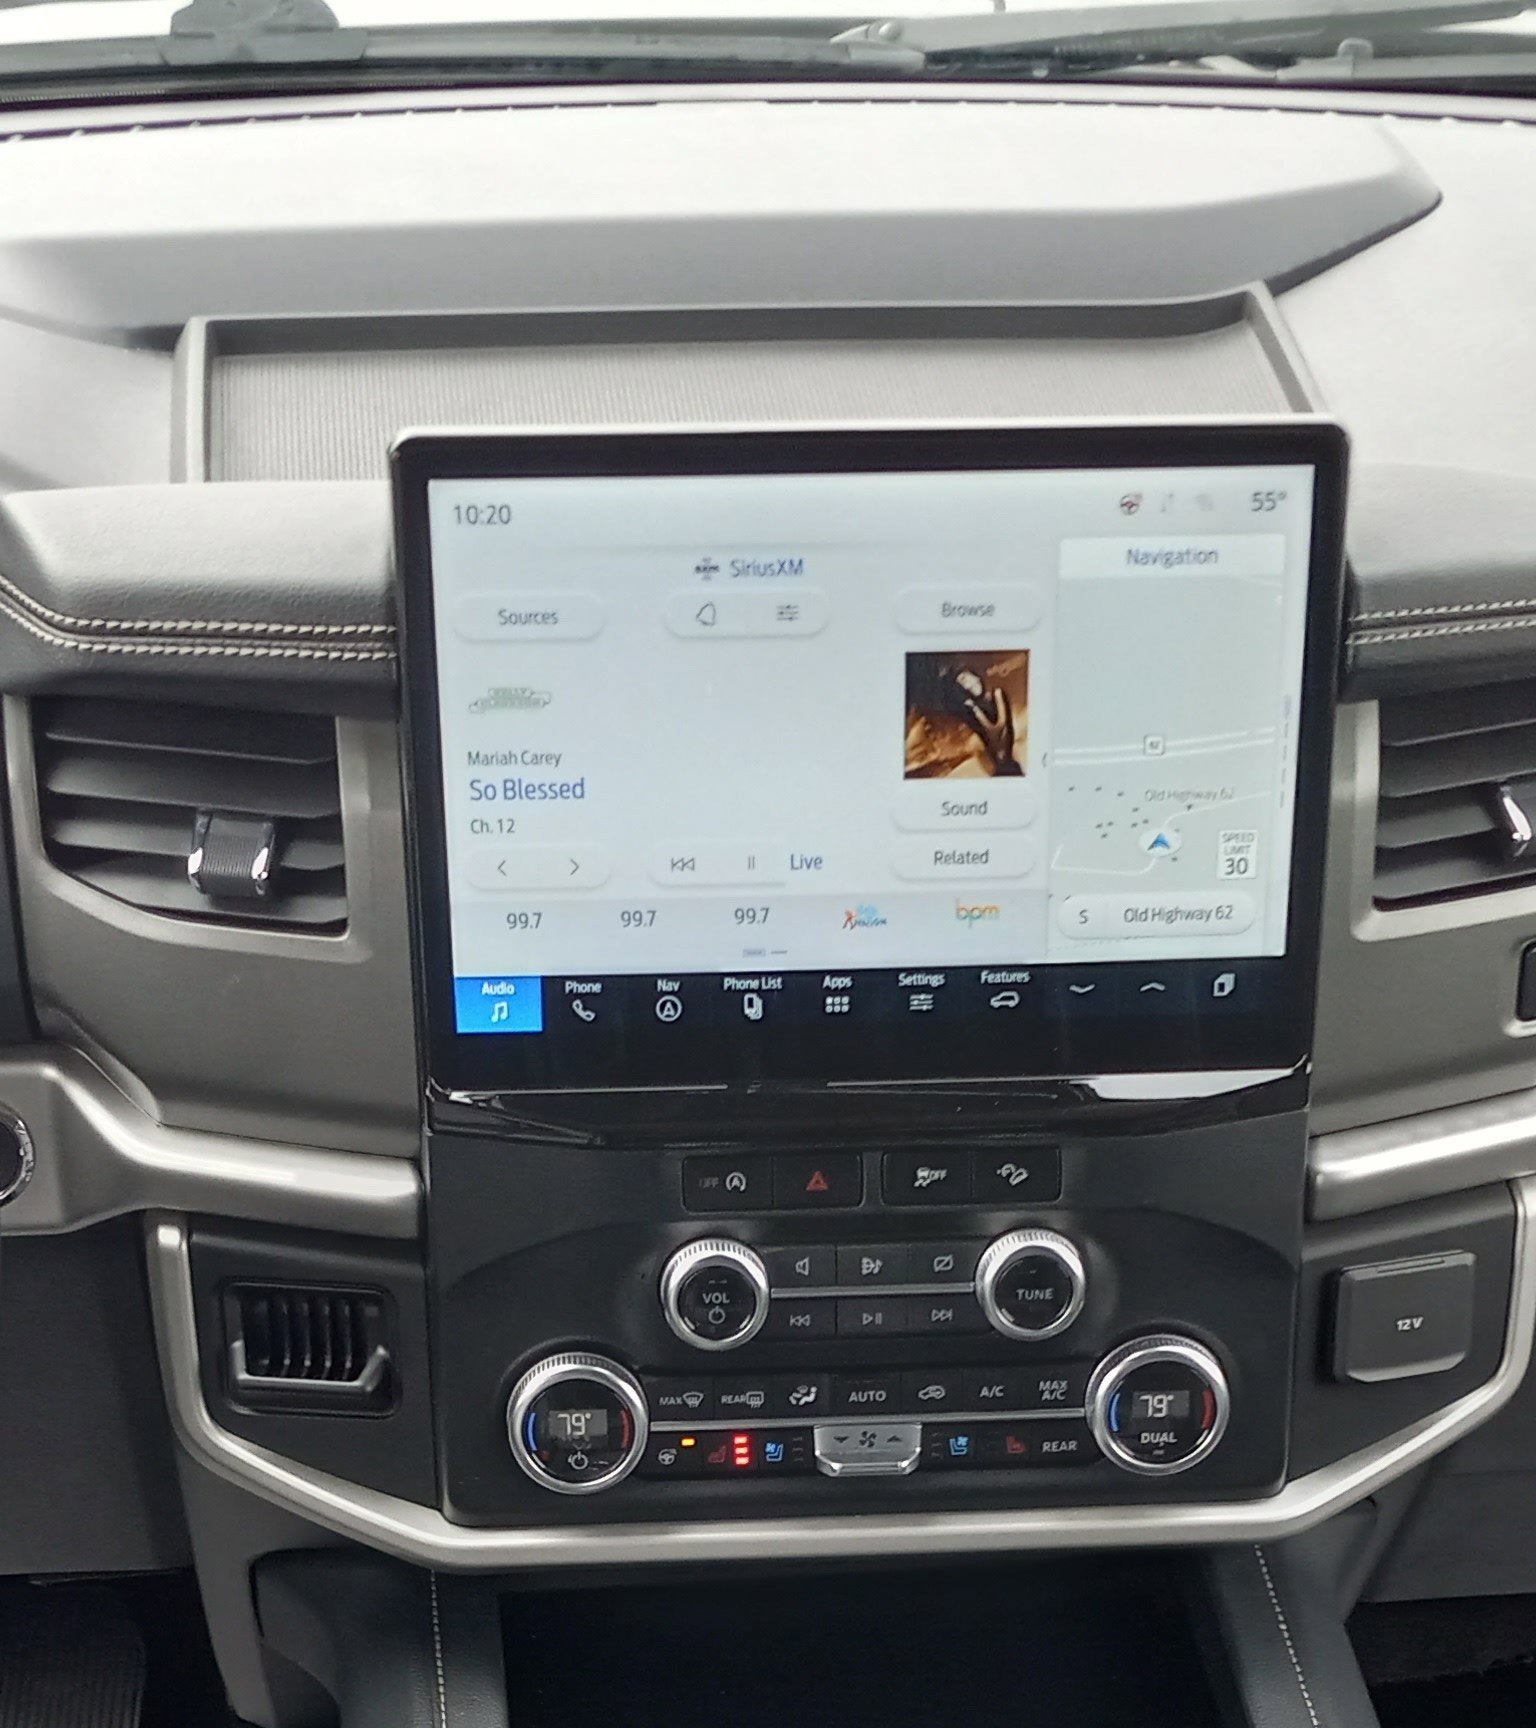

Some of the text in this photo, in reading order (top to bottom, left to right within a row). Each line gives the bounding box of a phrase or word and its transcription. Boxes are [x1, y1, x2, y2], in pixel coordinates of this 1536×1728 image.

[454, 504, 512, 525] 10:20
[1127, 548, 1220, 569] Navigation
[730, 558, 806, 578] SiriusXM
[497, 608, 560, 626] Sources
[941, 602, 996, 618] Browse
[467, 750, 563, 768] Mariah Carey
[469, 777, 585, 801] So Blessed
[1145, 787, 1235, 804] Old Highway 62
[941, 800, 989, 818] Sound
[470, 818, 516, 834] Ch. 12
[1221, 832, 1255, 844] SPEED
[933, 849, 991, 866] Related
[1224, 845, 1252, 856] LIMIT
[790, 853, 823, 871] Live
[1224, 857, 1249, 876] 30
[506, 911, 543, 929] 99.7
[620, 910, 657, 928] 99.7
[734, 907, 771, 925] 99.7
[955, 897, 1001, 928] bpm
[1078, 909, 1089, 925] S
[1123, 904, 1234, 924] Old Highway 62
[723, 976, 784, 992] Phone List
[822, 975, 853, 990] Apps
[897, 972, 947, 988] Settings
[979, 969, 1032, 985] Features
[480, 981, 516, 996] Audio
[564, 980, 603, 995] Phone
[656, 979, 681, 994] Nav
[702, 1292, 730, 1304] VOL
[1015, 1288, 1055, 1302] TUNE
[979, 1384, 1005, 1399] A/C
[1039, 1380, 1069, 1393] MAX
[659, 1395, 683, 1406] MAX
[721, 1394, 745, 1405] REAR
[848, 1390, 887, 1403] AUTO
[1041, 1388, 1066, 1402] A/C
[1140, 1431, 1178, 1445] DUAL
[1041, 1439, 1078, 1454] REAR
